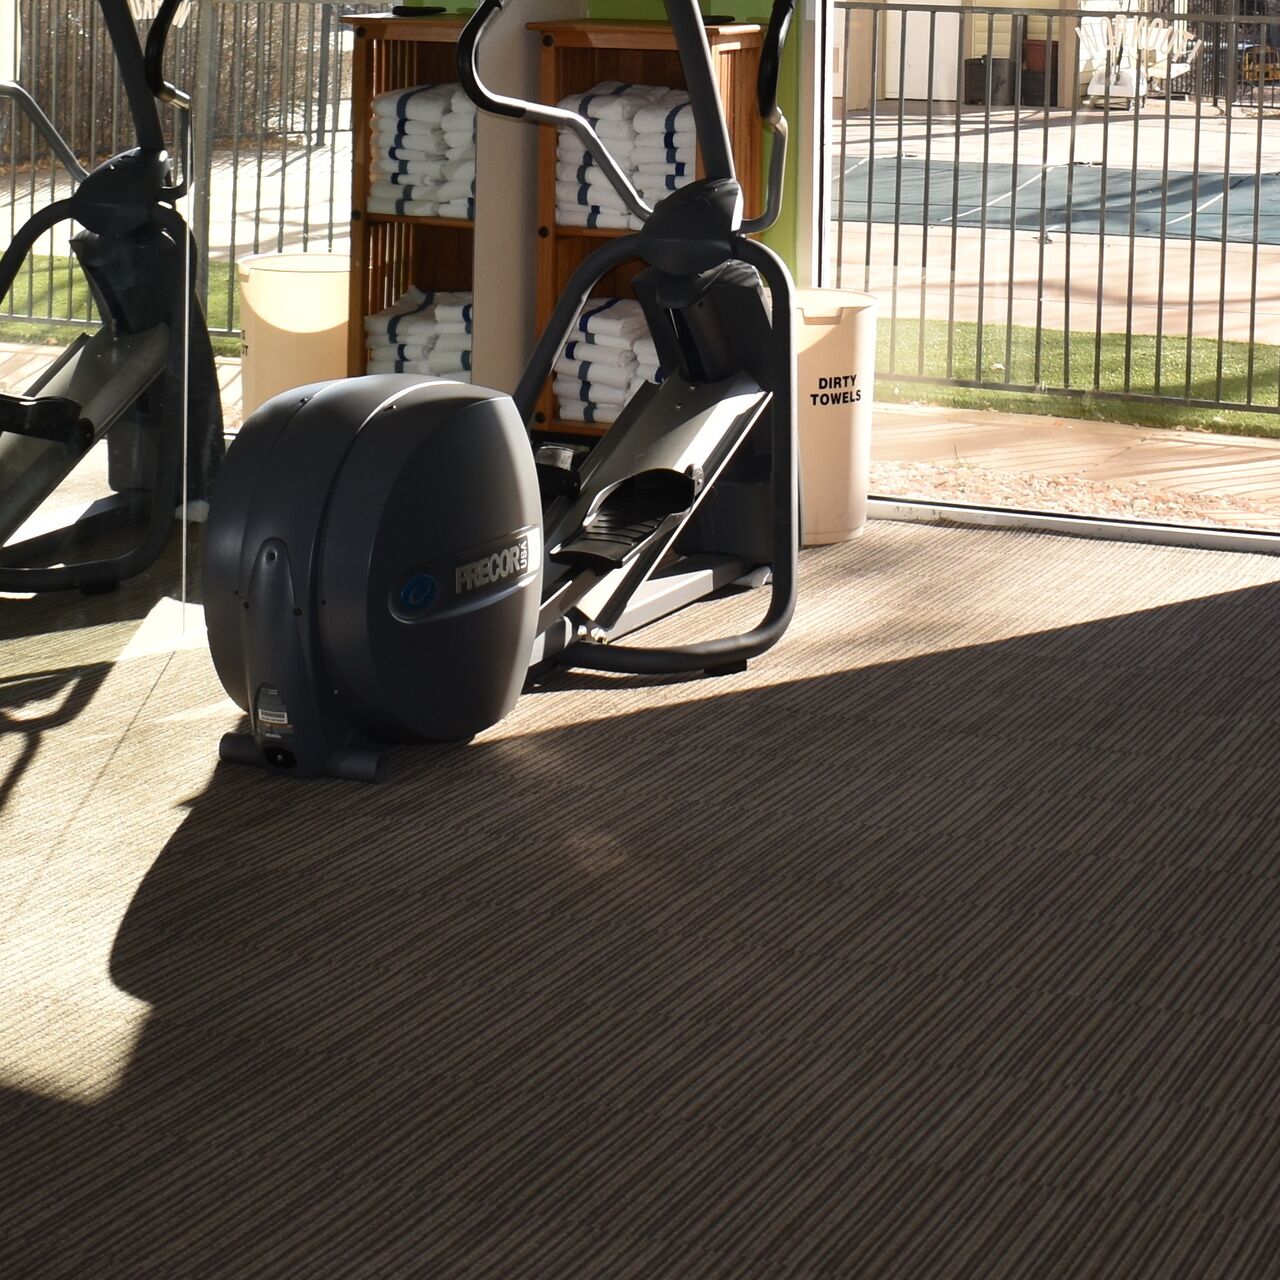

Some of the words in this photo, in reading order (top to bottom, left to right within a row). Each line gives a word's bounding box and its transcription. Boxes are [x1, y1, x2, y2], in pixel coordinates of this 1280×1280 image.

[818, 374, 857, 390] DIRTY
[810, 389, 862, 406] TOWELS
[455, 545, 520, 594] PRECOR
